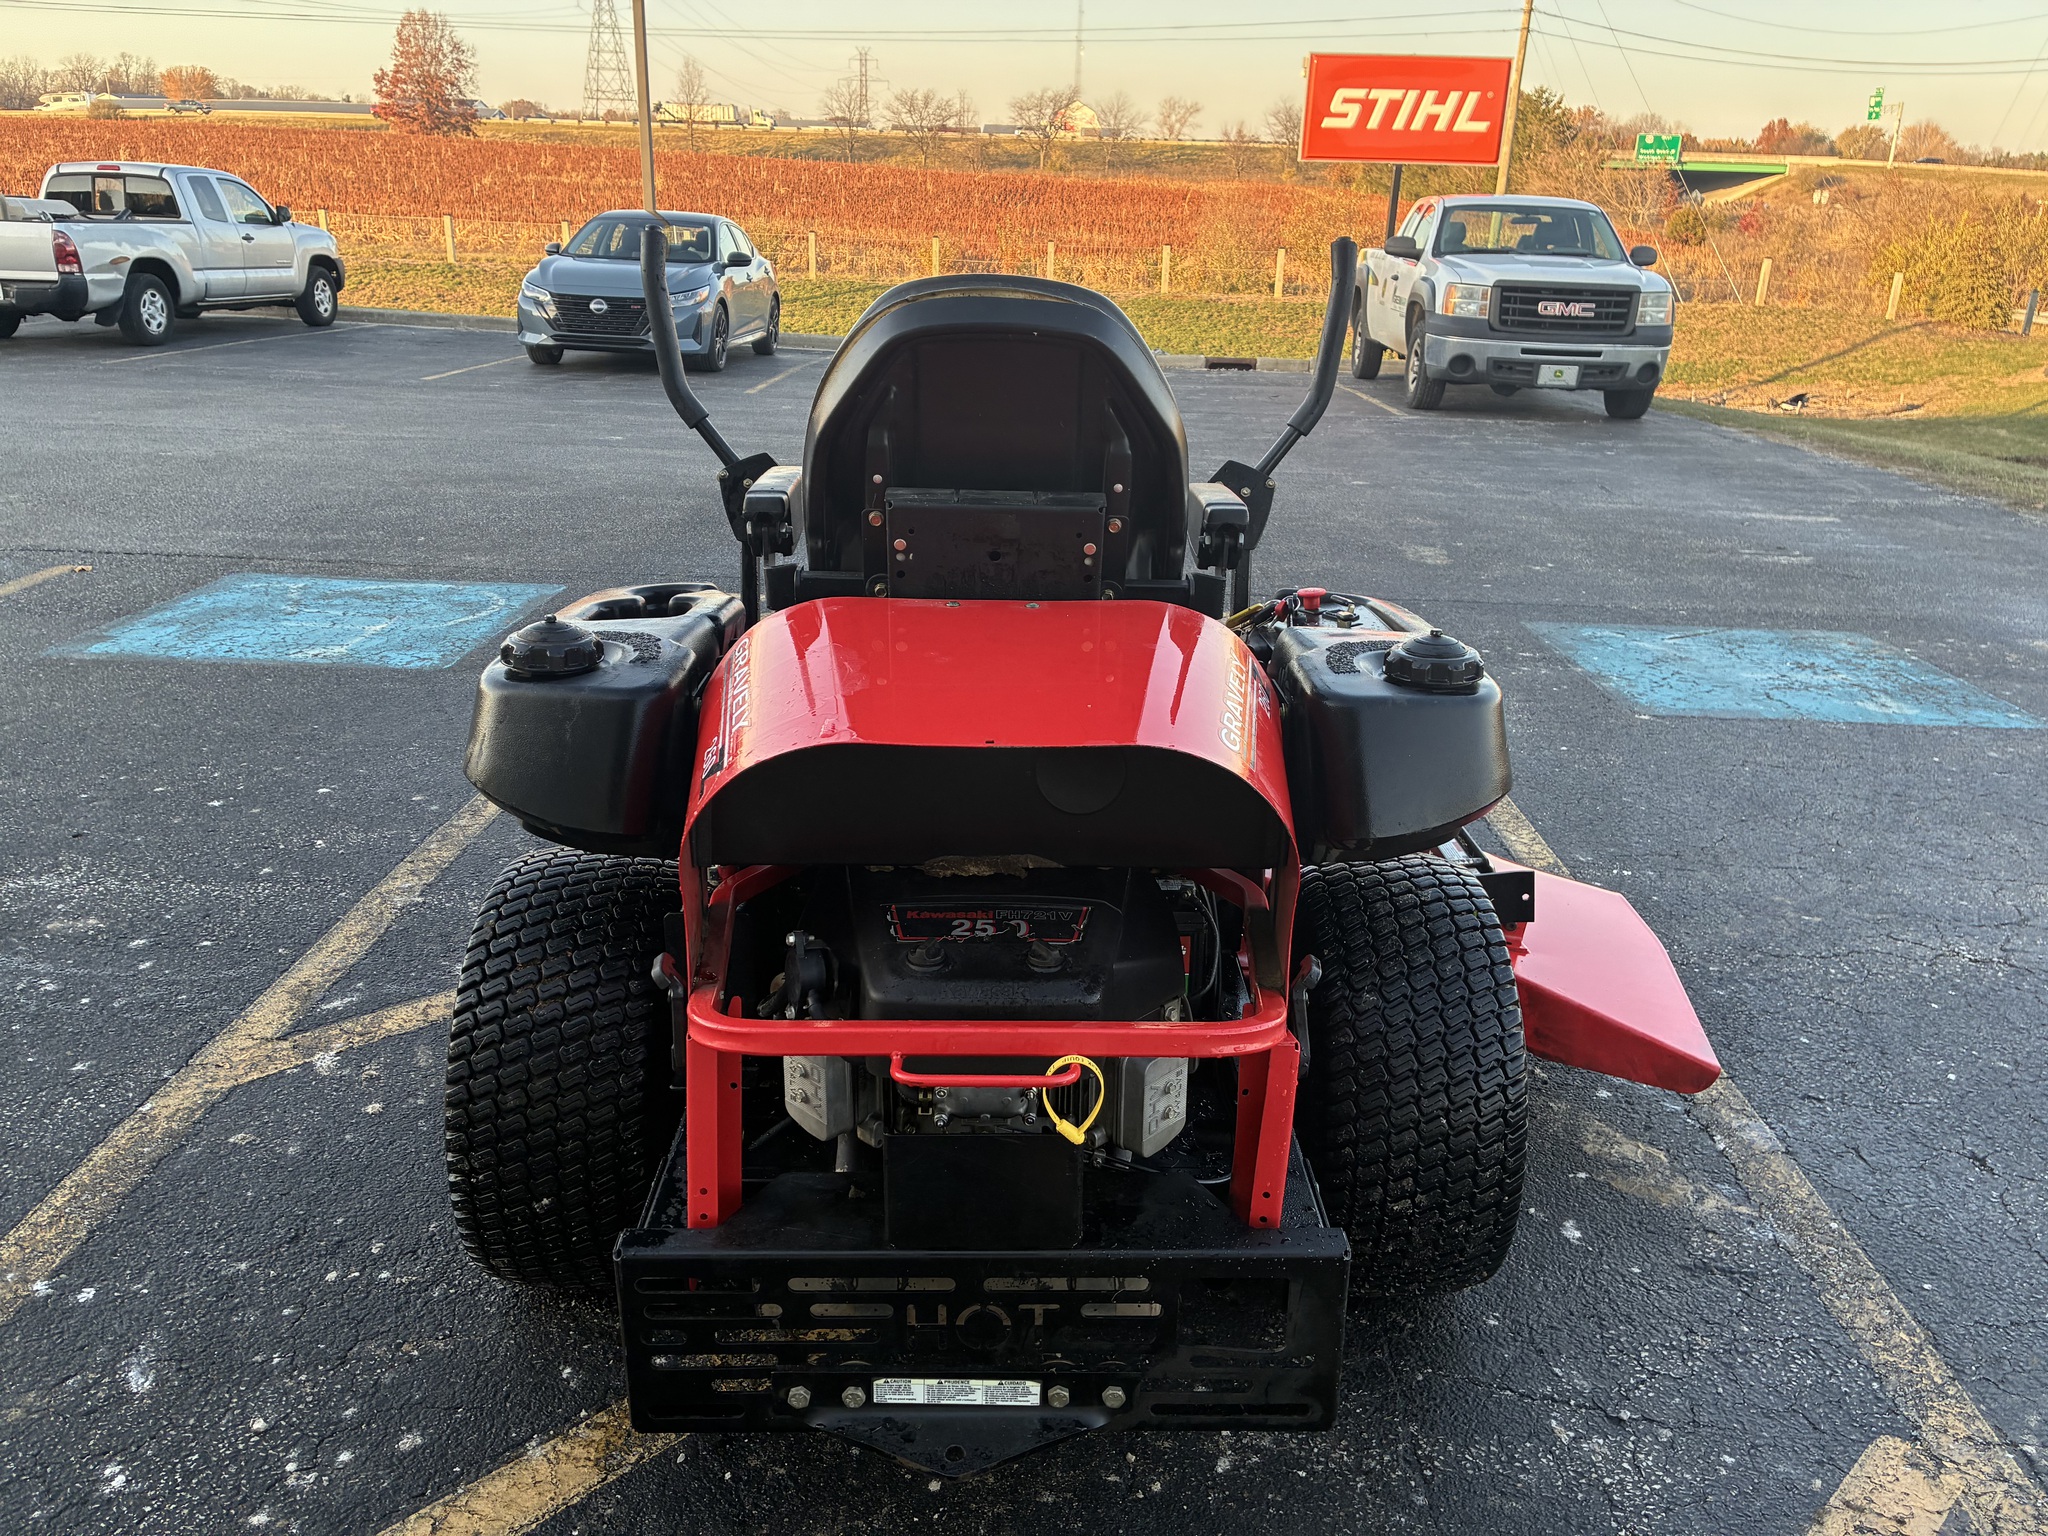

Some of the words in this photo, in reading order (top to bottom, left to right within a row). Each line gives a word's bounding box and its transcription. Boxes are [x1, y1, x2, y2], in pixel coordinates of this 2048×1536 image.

[1321, 88, 1490, 132] STIHL
[1537, 301, 1596, 318] GMC
[732, 637, 752, 732] GRAVELY
[1220, 654, 1247, 752] GRAVELY
[906, 910, 993, 919] Kawasaki
[995, 910, 1073, 920] FH721V
[906, 1303, 1061, 1350] HOT
